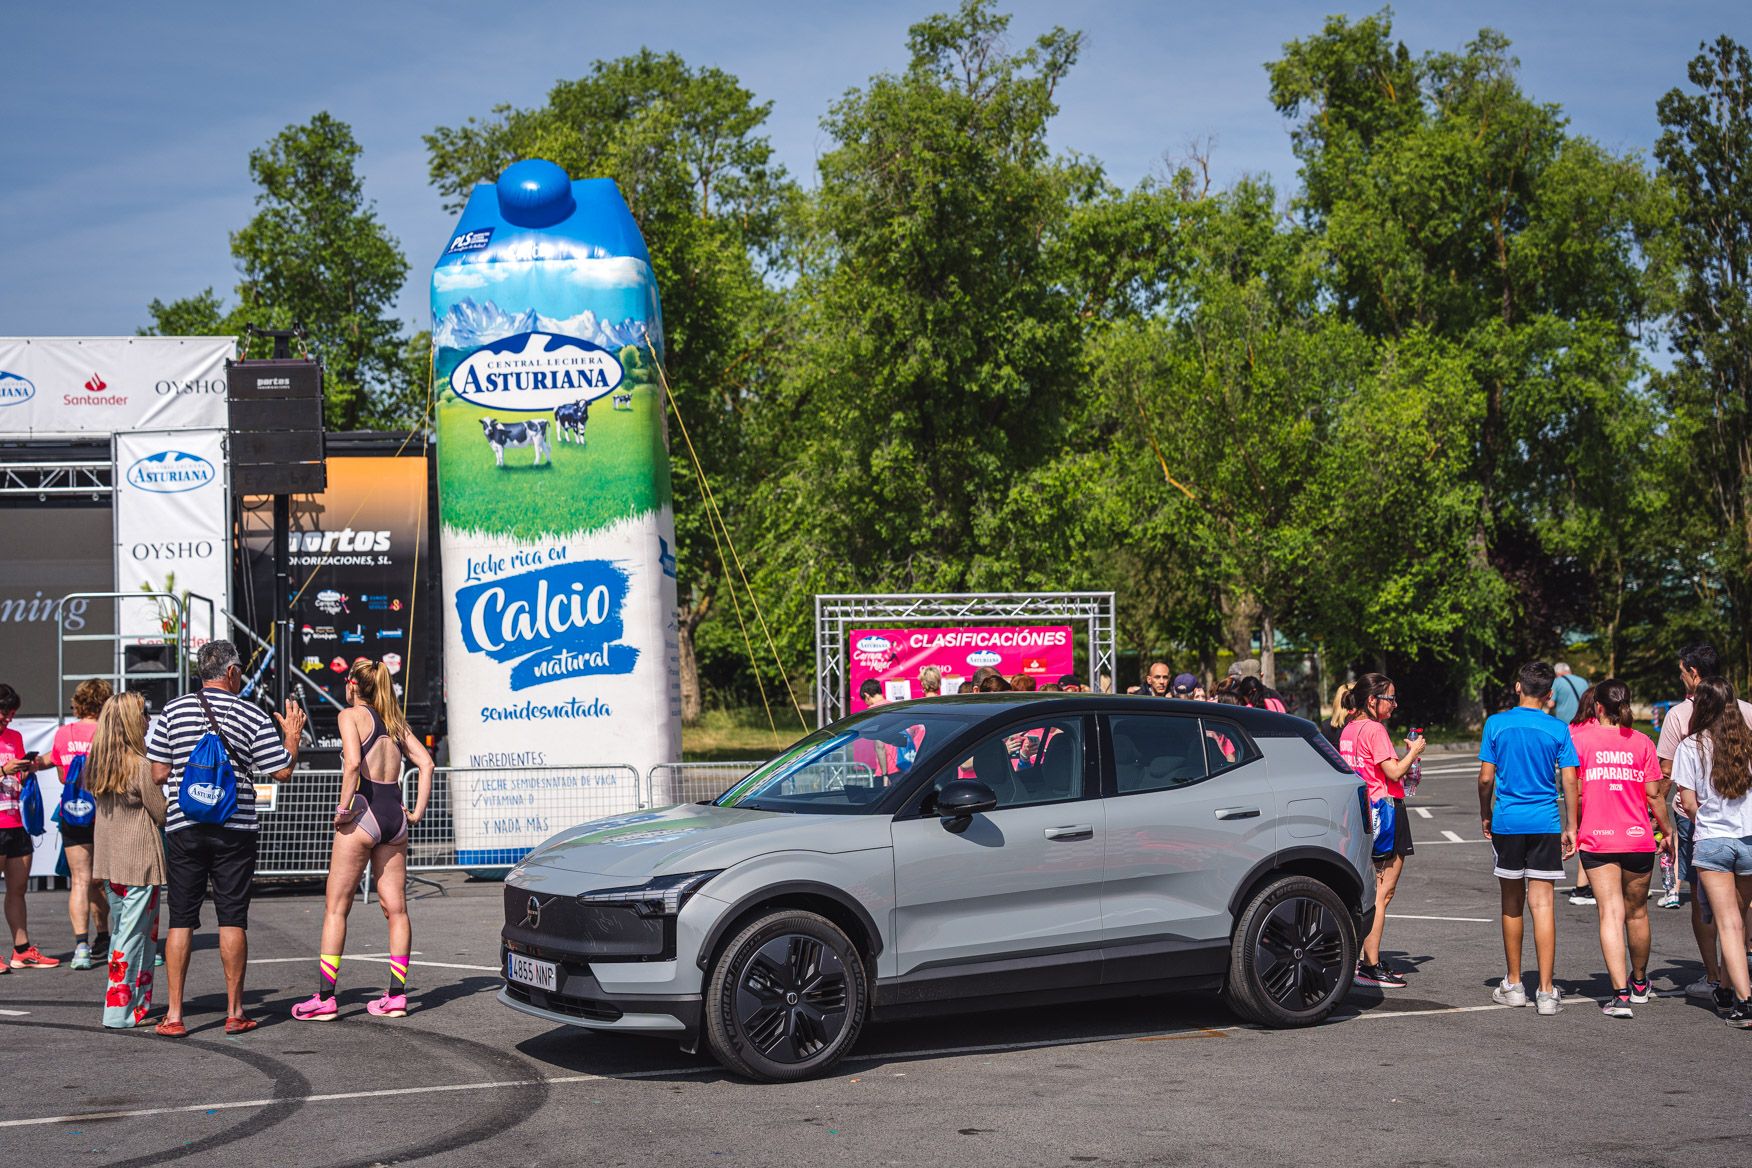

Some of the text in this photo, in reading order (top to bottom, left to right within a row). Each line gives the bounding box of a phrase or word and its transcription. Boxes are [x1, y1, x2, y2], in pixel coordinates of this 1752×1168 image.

[451, 232, 473, 249] PLS
[487, 357, 603, 369] CENTRAL LECHERA
[155, 380, 226, 395] OYSHO
[461, 364, 610, 394] ASTURIANA
[63, 394, 128, 406] Santander
[134, 467, 208, 483] ASTURIANA
[132, 540, 212, 561] OYSHO
[464, 546, 567, 583] Leche rica en
[471, 579, 609, 652] Calcio
[910, 630, 1067, 648] CLASIFICACIÓNES
[533, 642, 610, 677] natural
[919, 665, 952, 673] OHO
[480, 697, 612, 723] semidesnatada
[470, 752, 547, 767] INGREDIENTES:
[1596, 751, 1634, 765] SOMOS
[482, 774, 616, 791] LECHE SEMIDESNATADA DE VACA
[1586, 767, 1645, 783] IMPARABLES
[483, 794, 524, 806] VITAMINA
[494, 817, 521, 834] NADA
[514, 958, 533, 981] 4855
